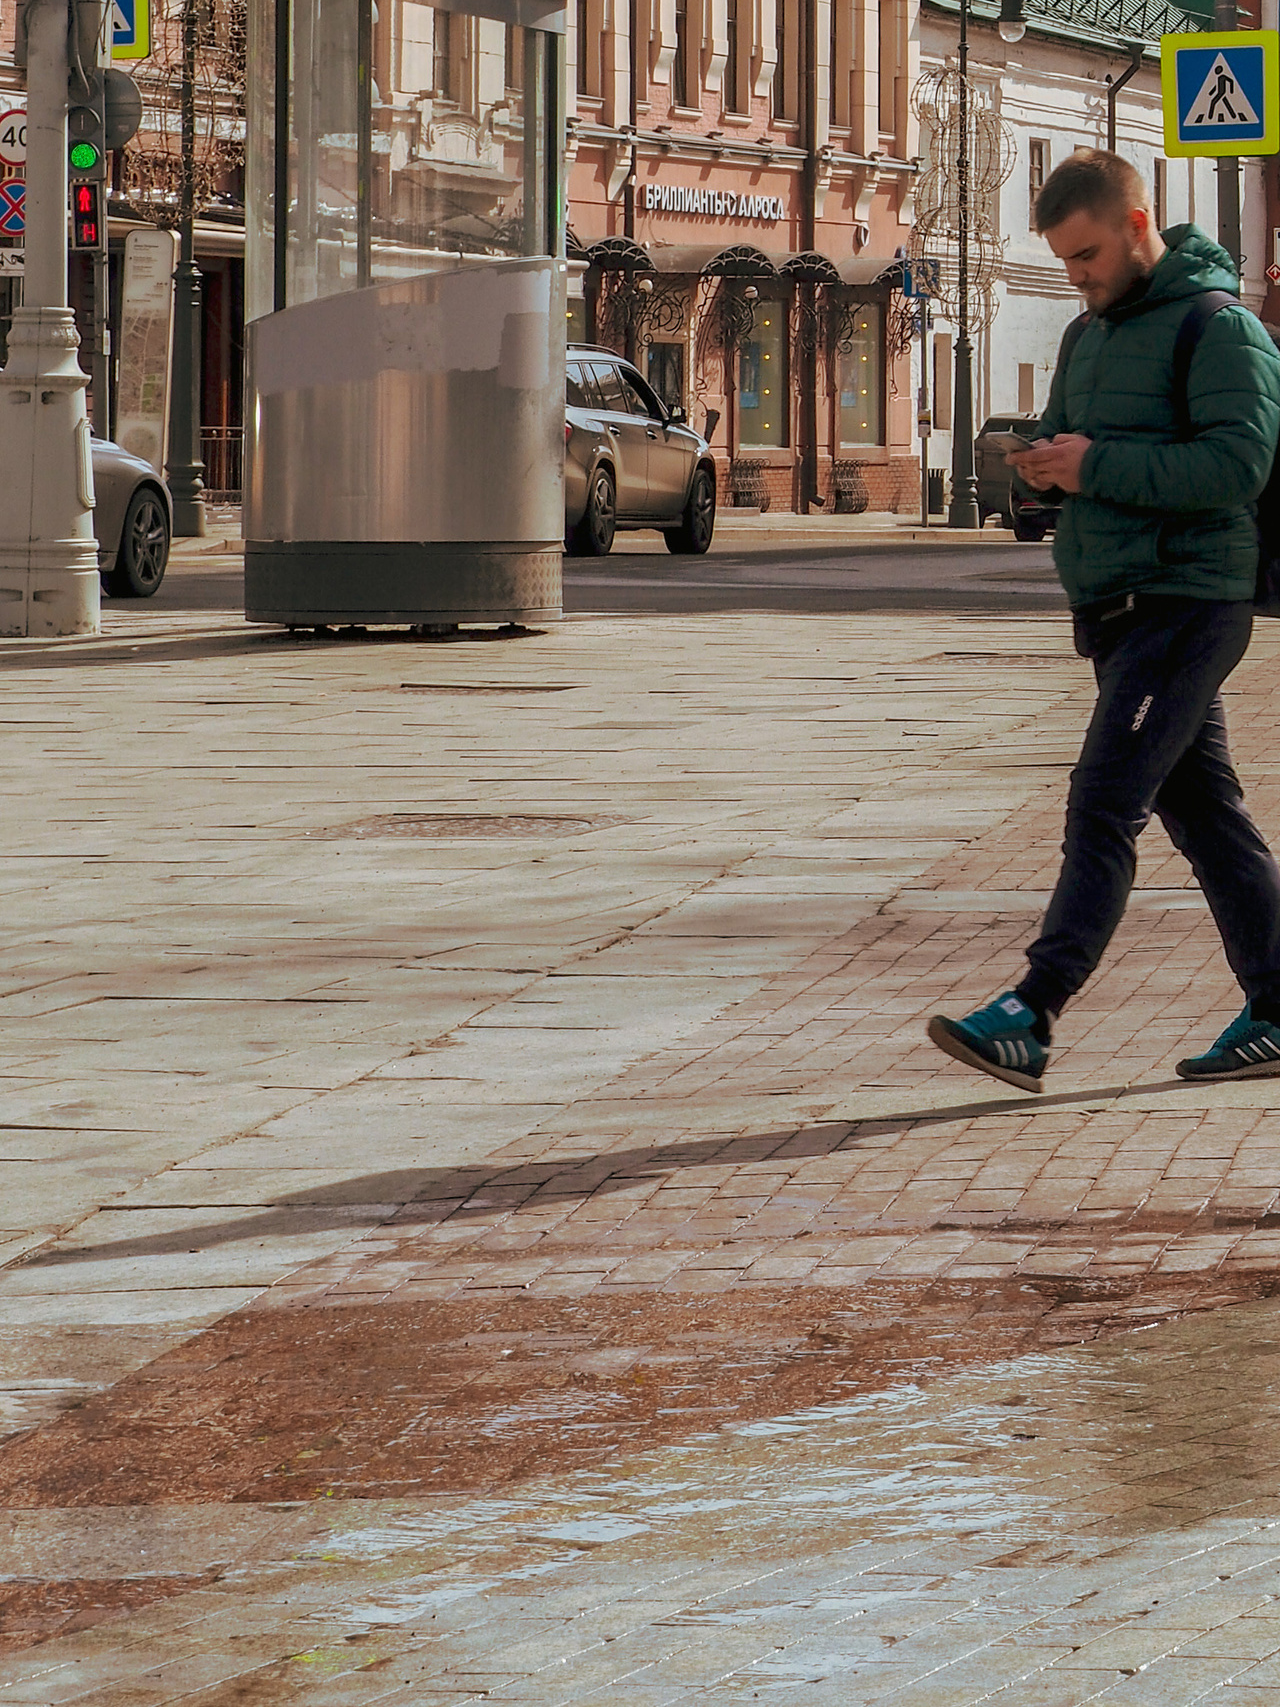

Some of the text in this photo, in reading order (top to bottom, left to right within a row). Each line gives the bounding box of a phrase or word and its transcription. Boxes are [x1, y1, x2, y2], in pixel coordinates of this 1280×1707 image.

[645, 183, 786, 220] БРИЛЛИАНТЫ АЛРОСА
[1131, 694, 1154, 732] adidas
